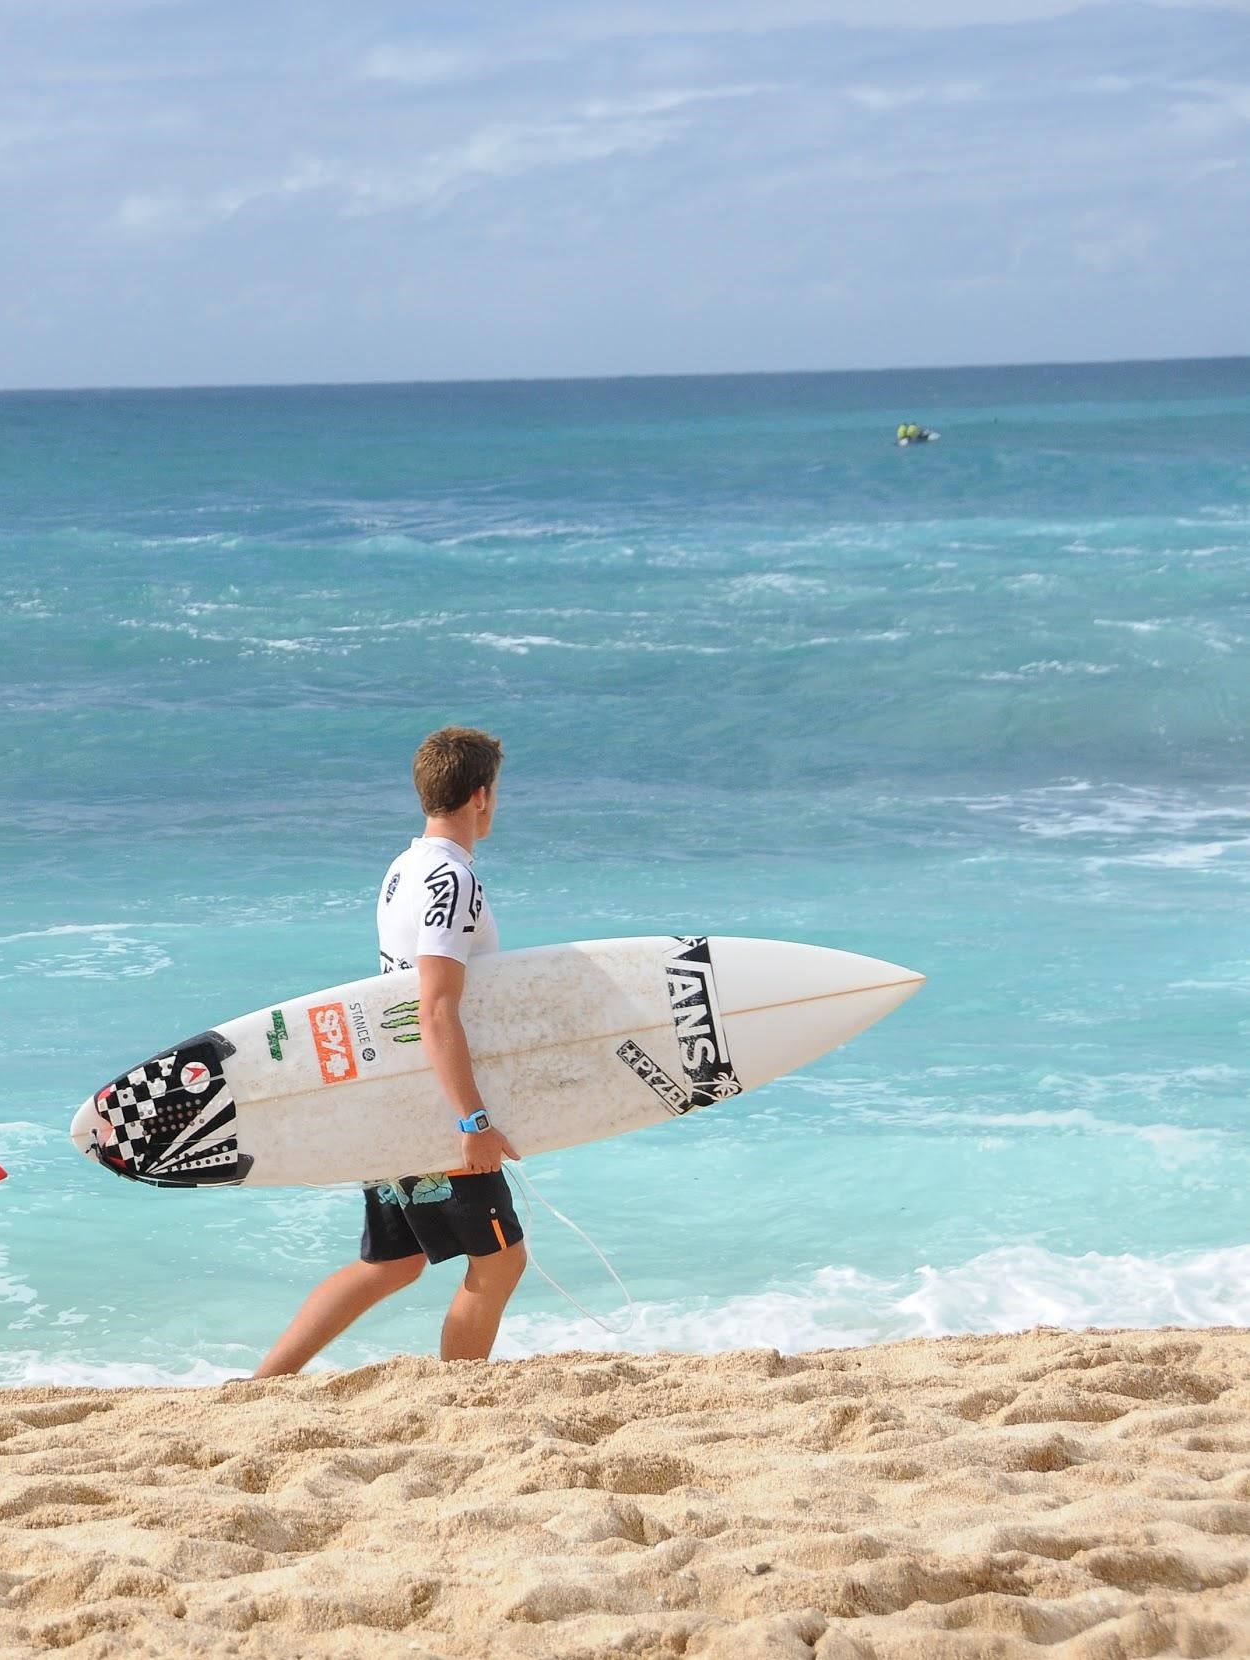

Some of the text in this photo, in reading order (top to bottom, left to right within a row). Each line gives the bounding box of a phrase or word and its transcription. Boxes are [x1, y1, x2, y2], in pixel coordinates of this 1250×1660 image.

[424, 862, 459, 929] VANS
[350, 1002, 371, 1044] STANCE
[662, 938, 730, 1070] VANS
[632, 1059, 689, 1114] PYZEL
